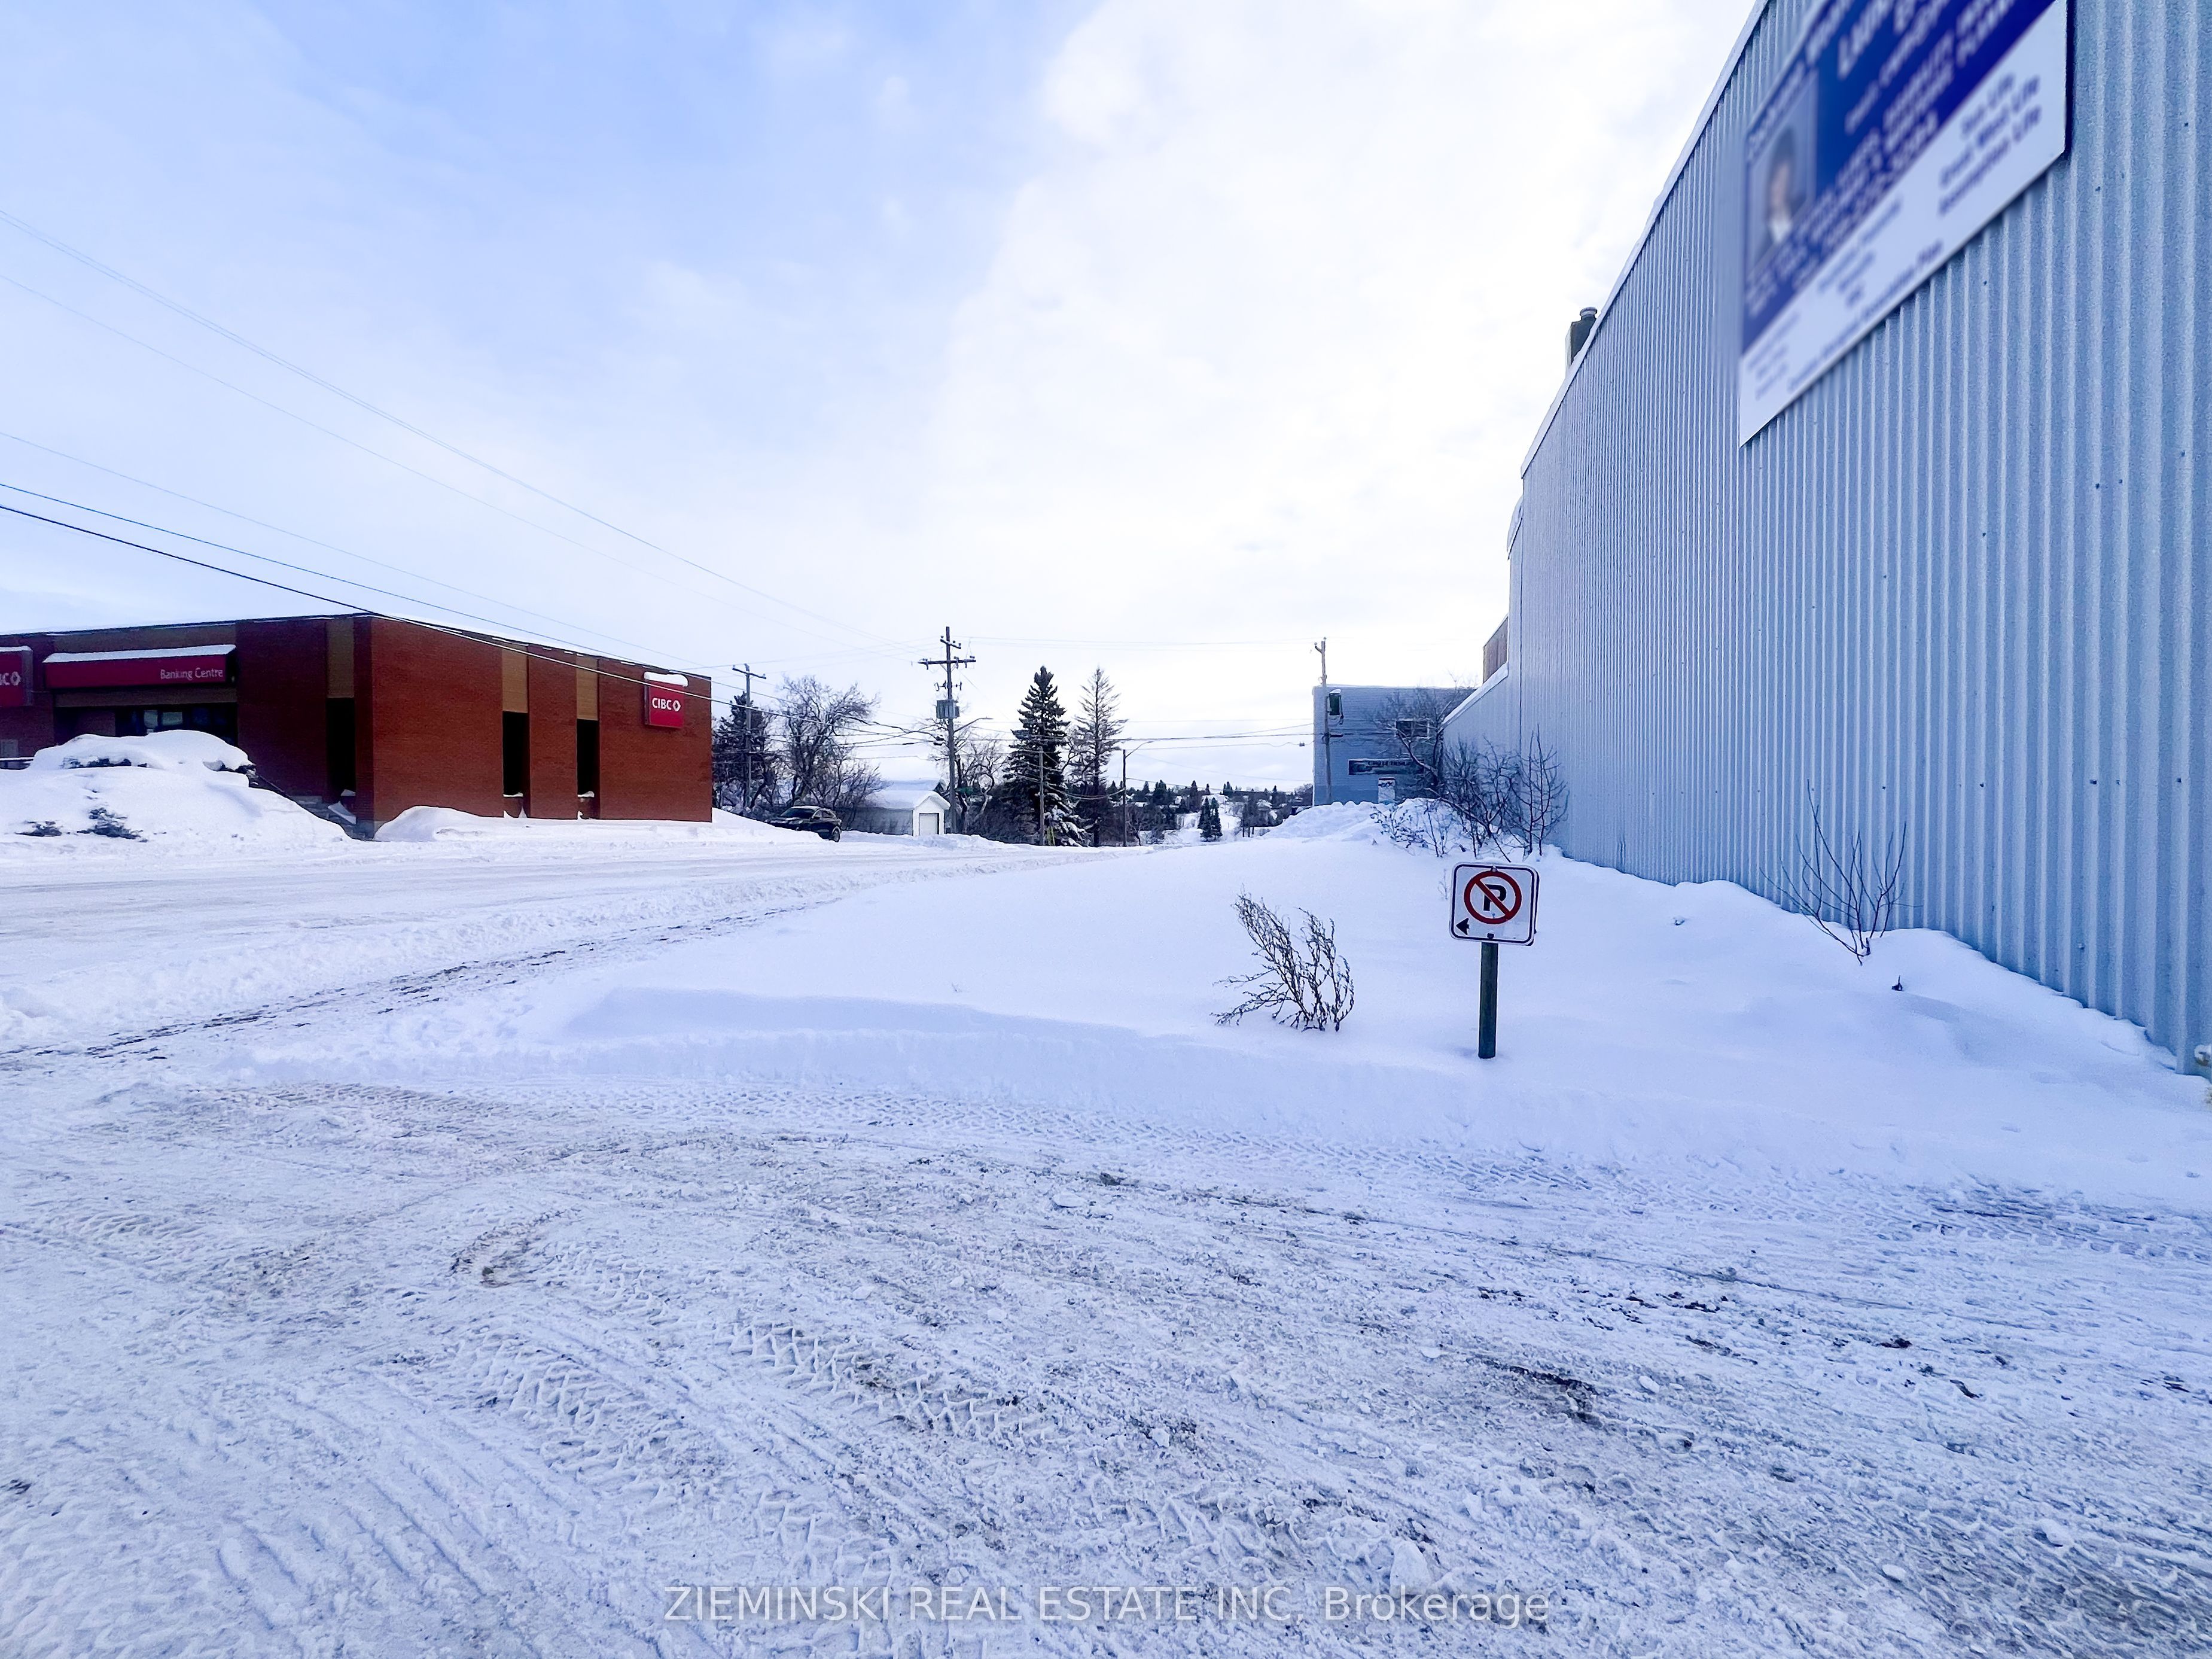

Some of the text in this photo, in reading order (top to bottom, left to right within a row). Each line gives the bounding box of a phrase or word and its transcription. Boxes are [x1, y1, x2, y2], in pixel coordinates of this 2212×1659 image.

[160, 667, 223, 681] Banking Centre
[651, 698, 672, 710] CIBC
